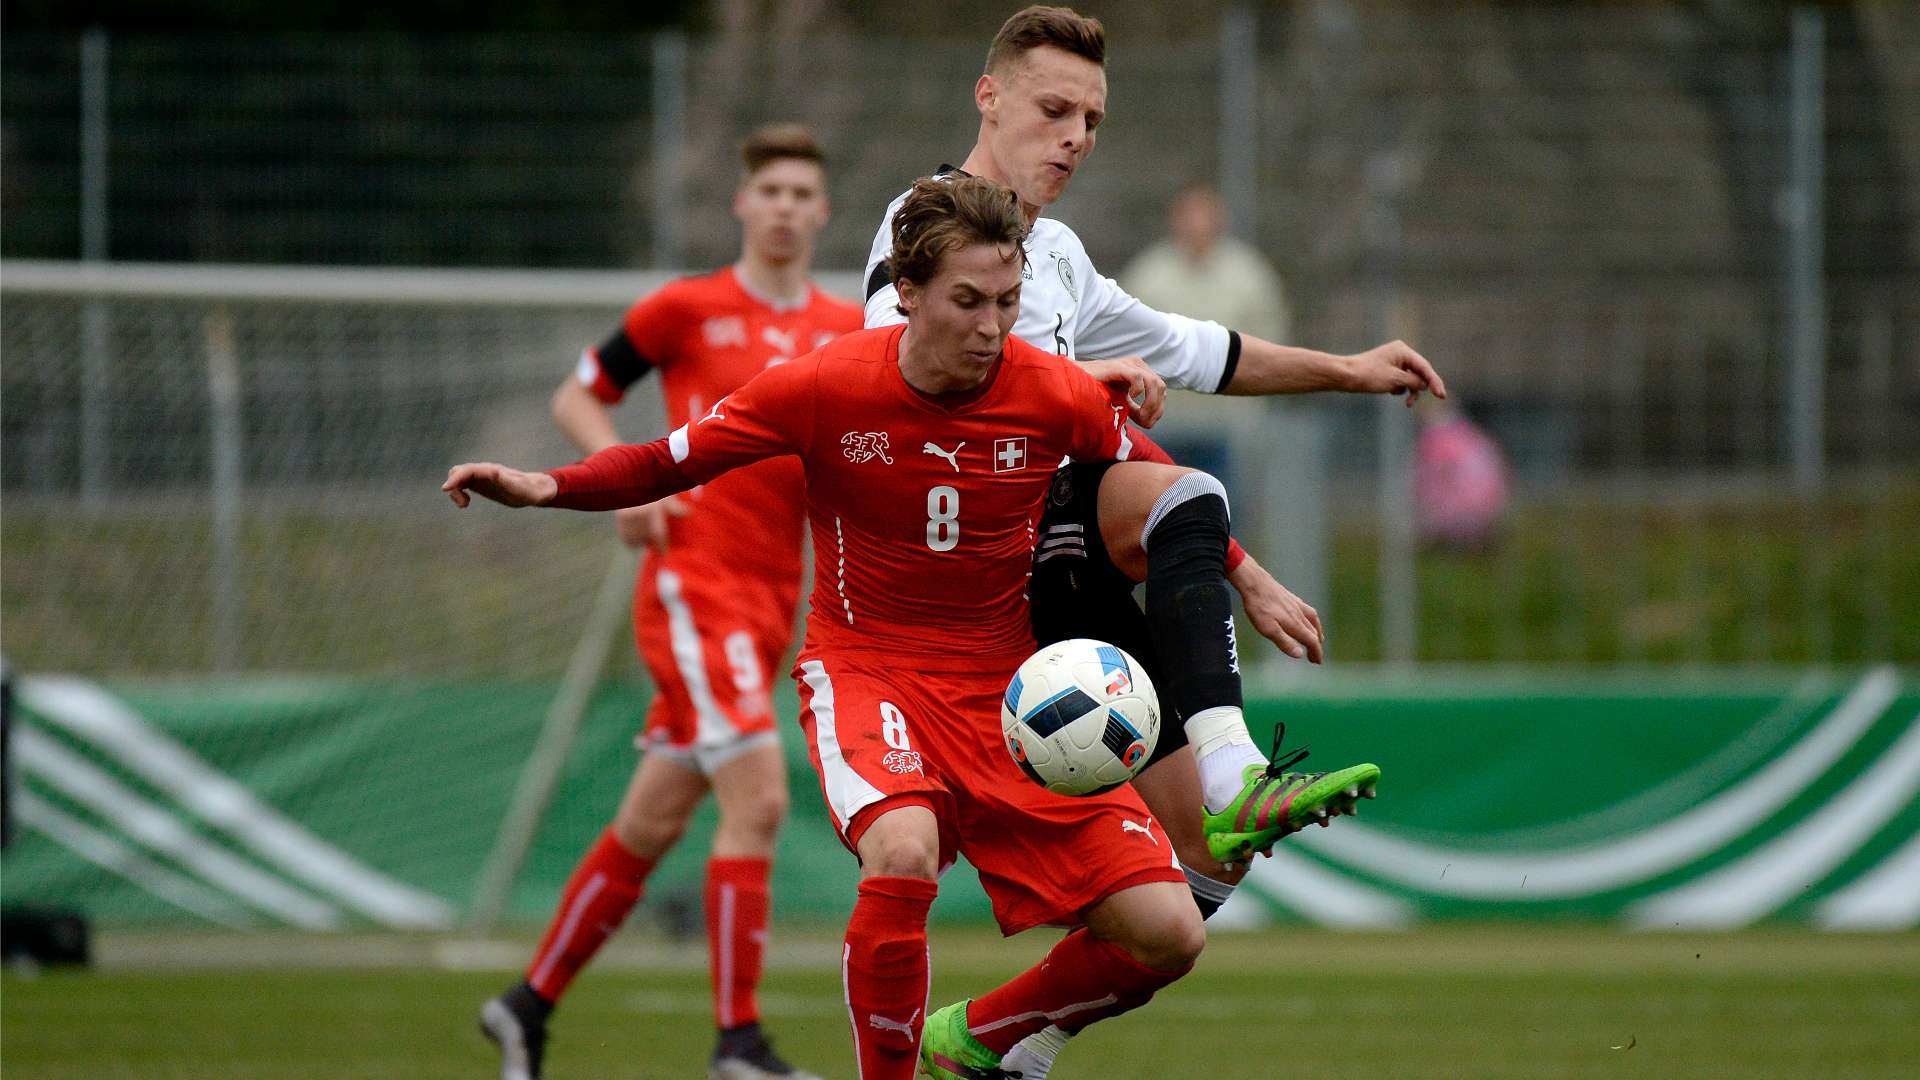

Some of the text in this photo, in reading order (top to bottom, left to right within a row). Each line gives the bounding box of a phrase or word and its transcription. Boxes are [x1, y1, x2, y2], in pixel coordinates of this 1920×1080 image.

[926, 485, 960, 552] 8
[724, 631, 762, 691] 9
[879, 701, 911, 751] 8
